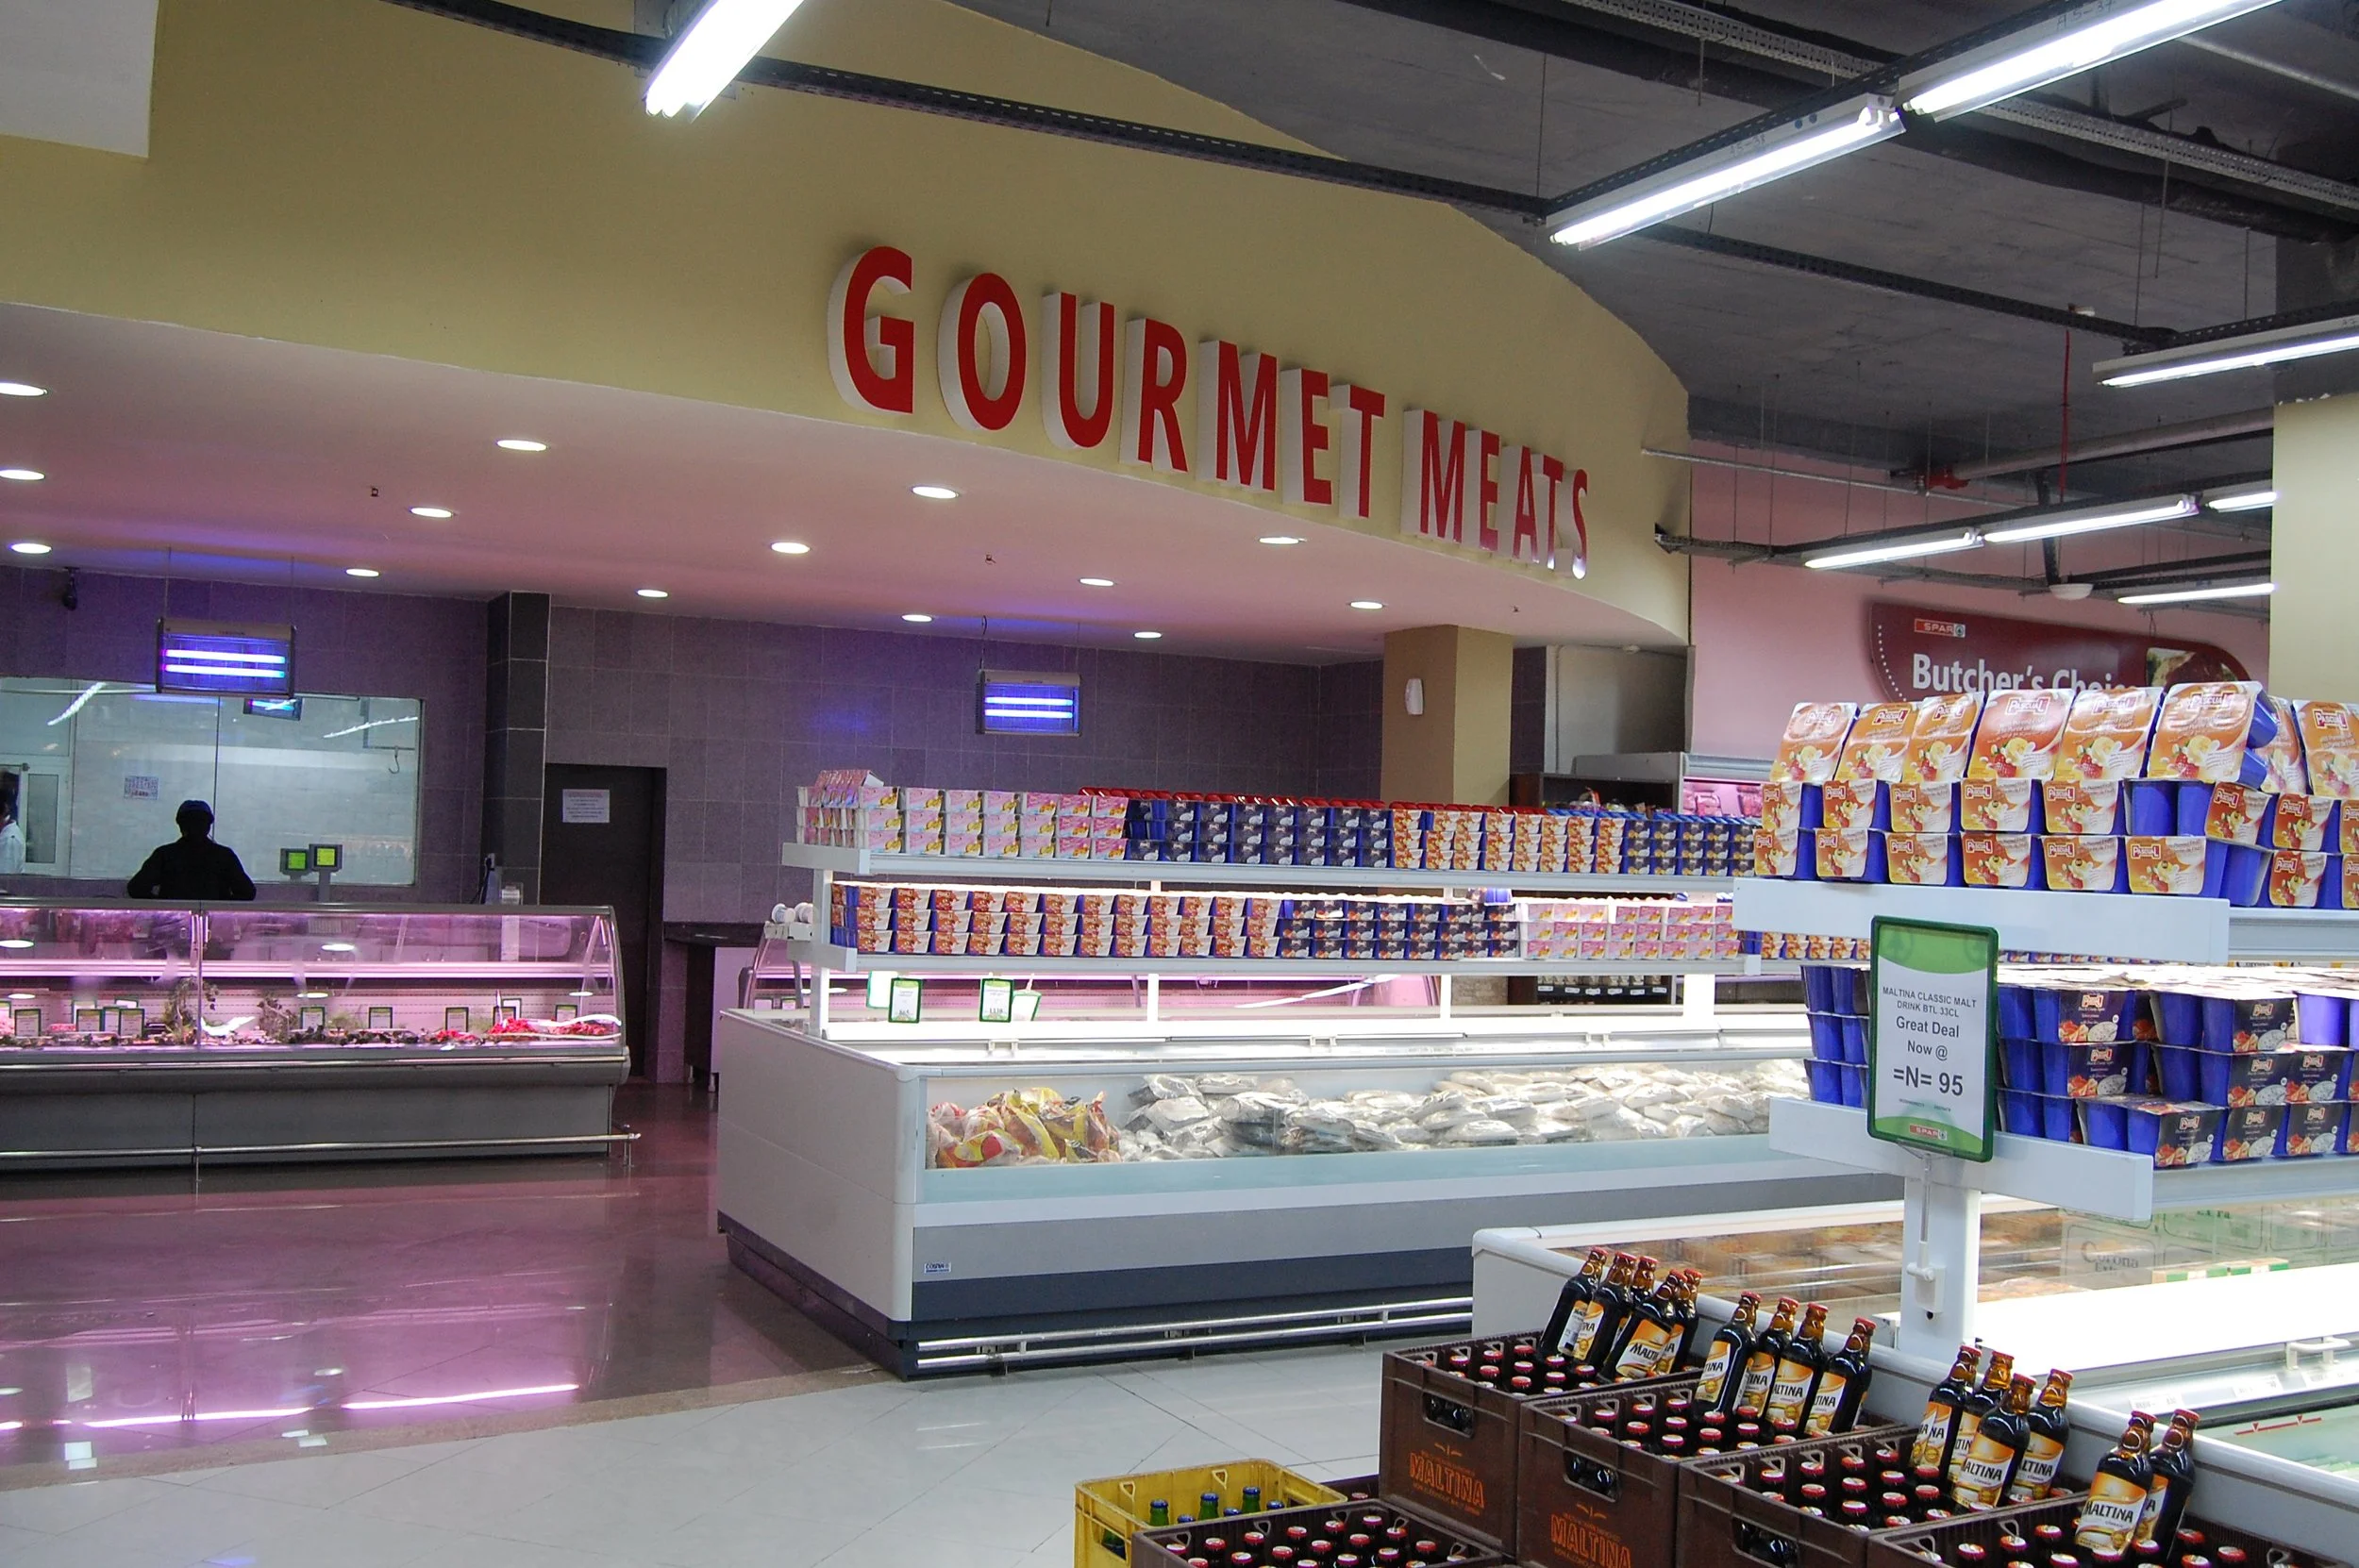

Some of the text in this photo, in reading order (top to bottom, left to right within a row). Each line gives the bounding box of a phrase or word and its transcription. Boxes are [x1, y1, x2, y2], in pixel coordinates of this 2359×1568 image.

[839, 246, 1589, 579] GOURMET MEATS
[1923, 622, 1954, 634] SPAR
[1913, 653, 2045, 693] Butcher's
[1882, 986, 1977, 1008] MALTINA CLASSIC MALT
[1897, 1000, 1960, 1017] DRINK BTL 33CL
[1896, 1015, 1960, 1038] Great Deal
[1907, 1040, 1949, 1061] Now @
[1893, 1065, 1964, 1096] =N= 95
[1409, 1452, 1484, 1510] MALTINA
[1963, 1460, 2003, 1481] ALTINA
[1550, 1513, 1631, 1568] MALTINA
